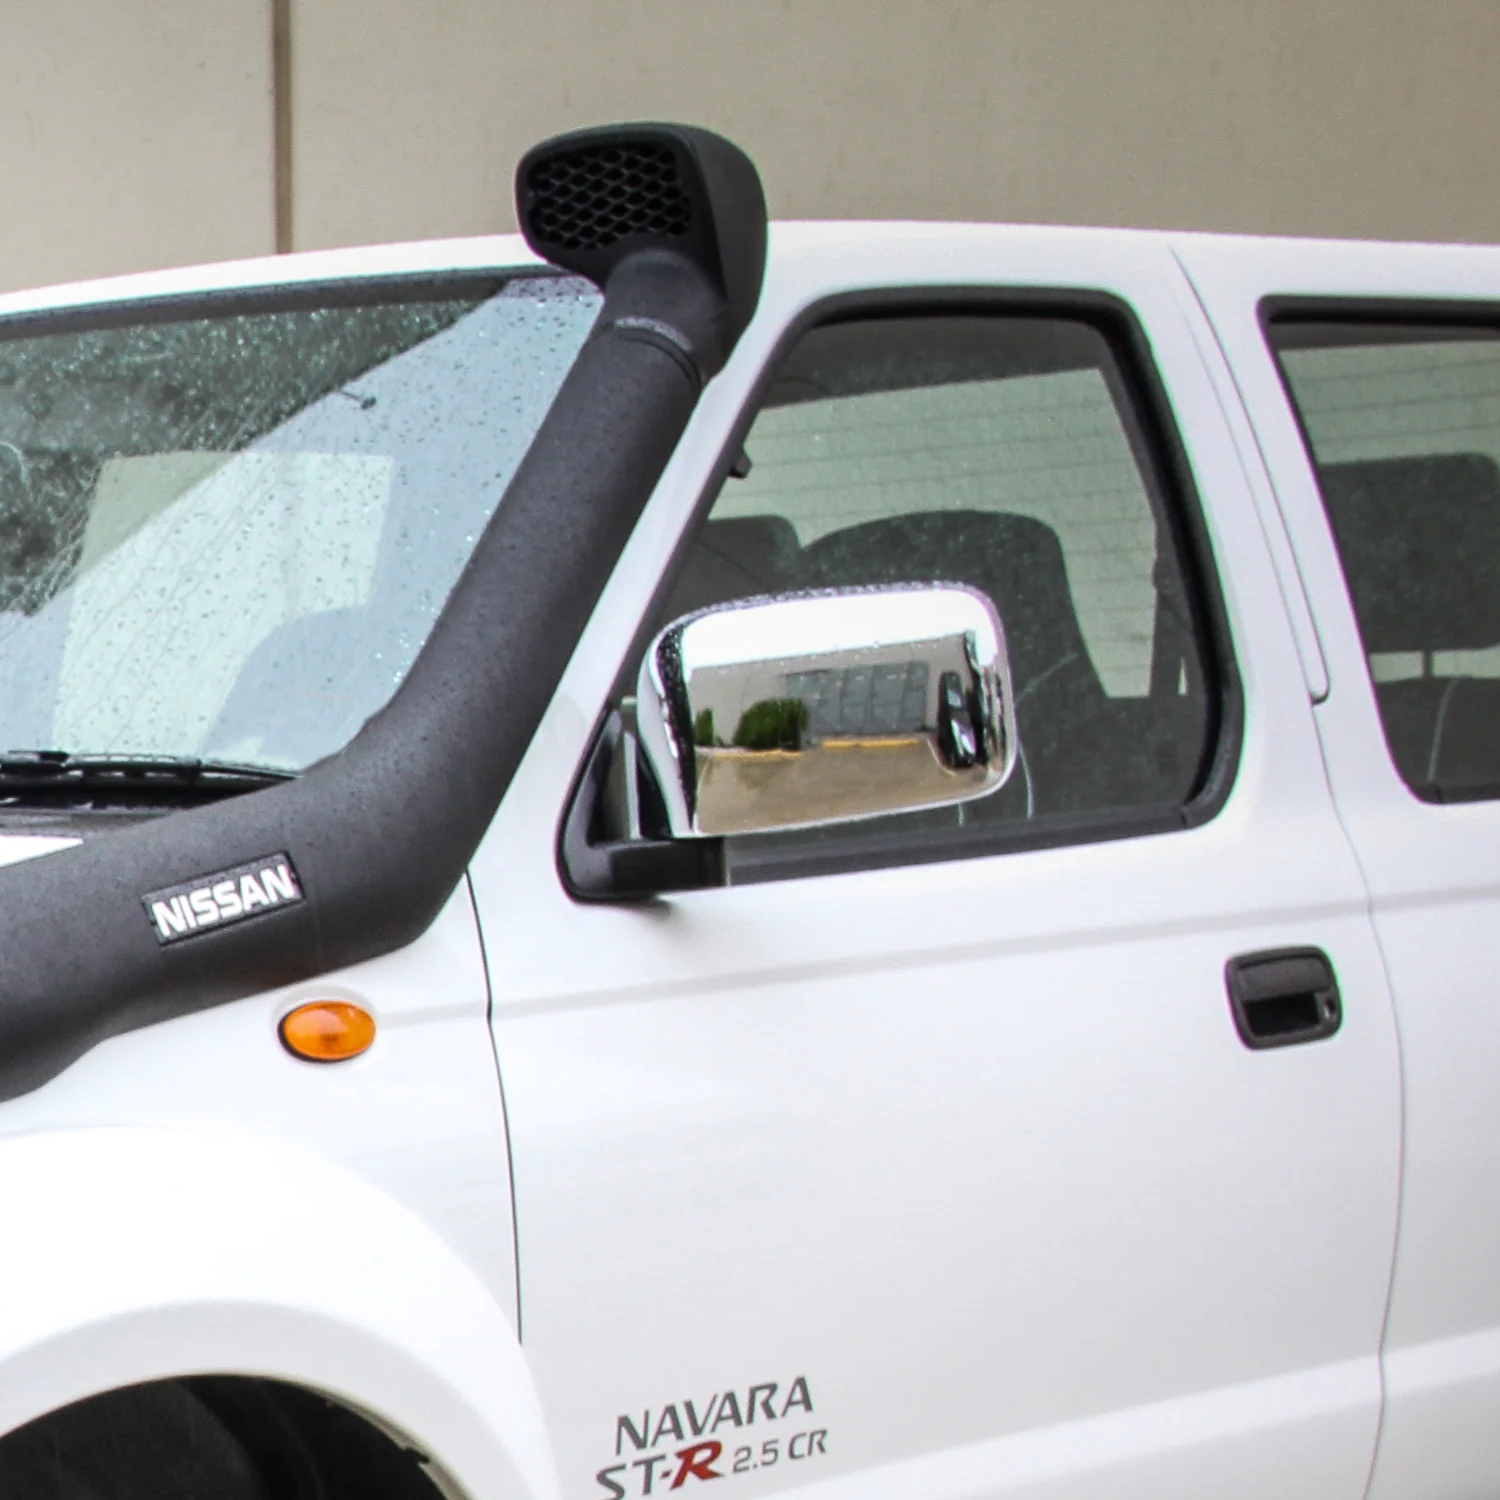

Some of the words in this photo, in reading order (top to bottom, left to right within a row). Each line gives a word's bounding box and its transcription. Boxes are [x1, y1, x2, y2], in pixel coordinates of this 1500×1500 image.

[152, 864, 297, 937] NISSAN
[615, 1375, 814, 1457] NAVARA
[732, 1438, 780, 1474] 2.5
[787, 1428, 829, 1460] CR
